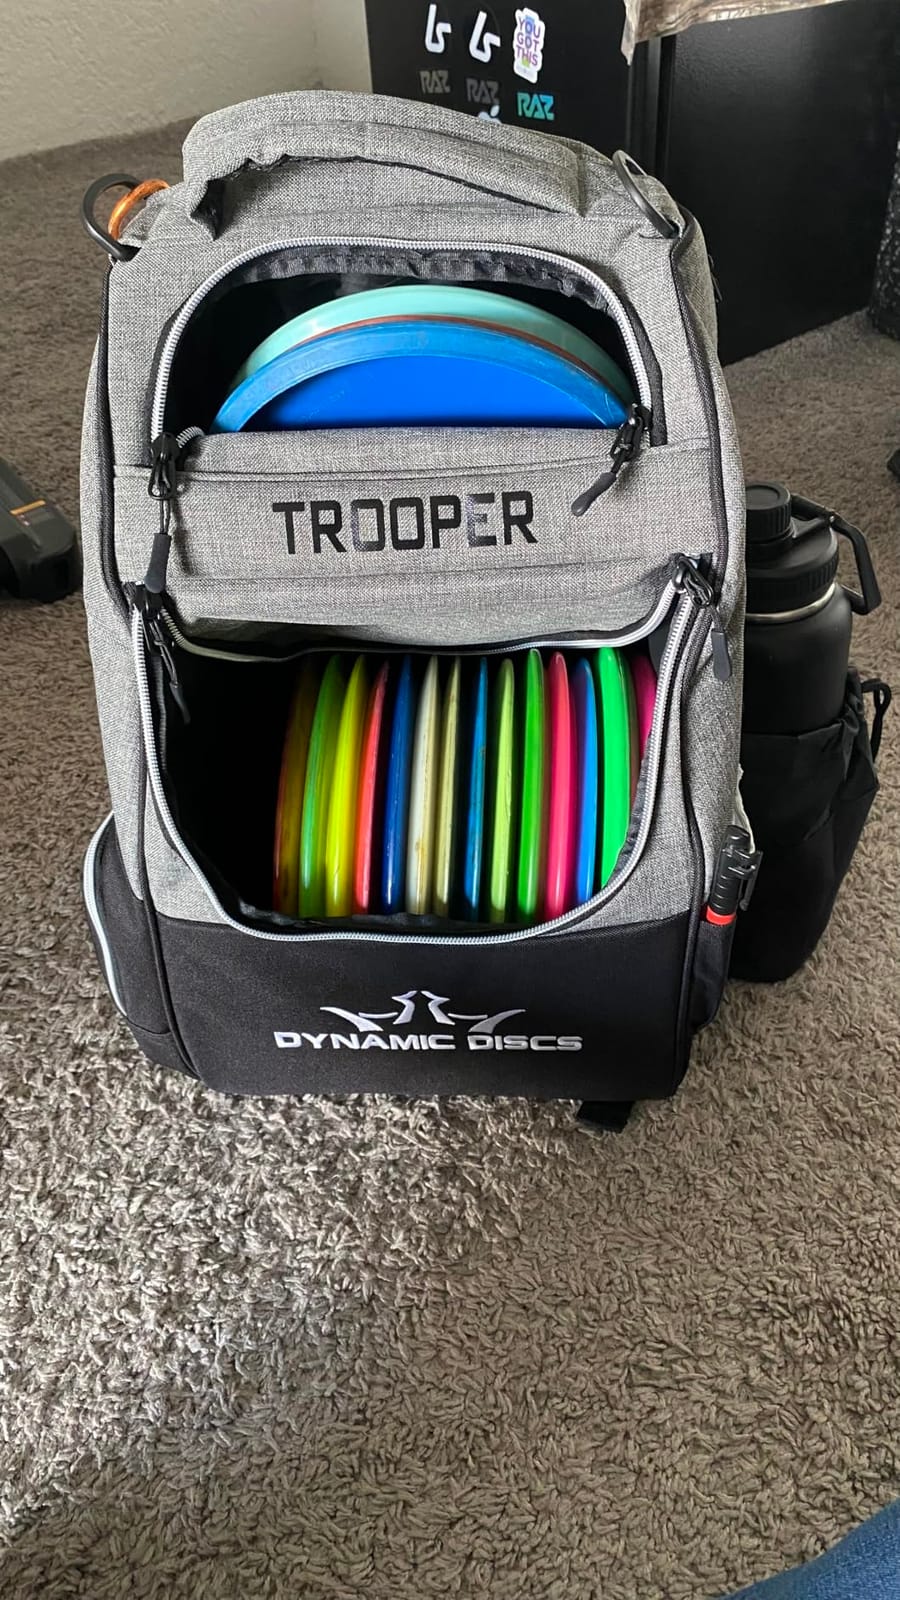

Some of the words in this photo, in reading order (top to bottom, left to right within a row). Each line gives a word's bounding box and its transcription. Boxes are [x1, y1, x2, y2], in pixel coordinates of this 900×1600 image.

[518, 16, 541, 38] YOU
[517, 32, 540, 52] GOT
[516, 44, 539, 66] THIS
[419, 70, 451, 94] RAZ
[517, 91, 555, 121] RAZ
[272, 490, 539, 555] TROOPER
[273, 1031, 456, 1050] DYNAMIC
[467, 1035, 583, 1051] DISCS
